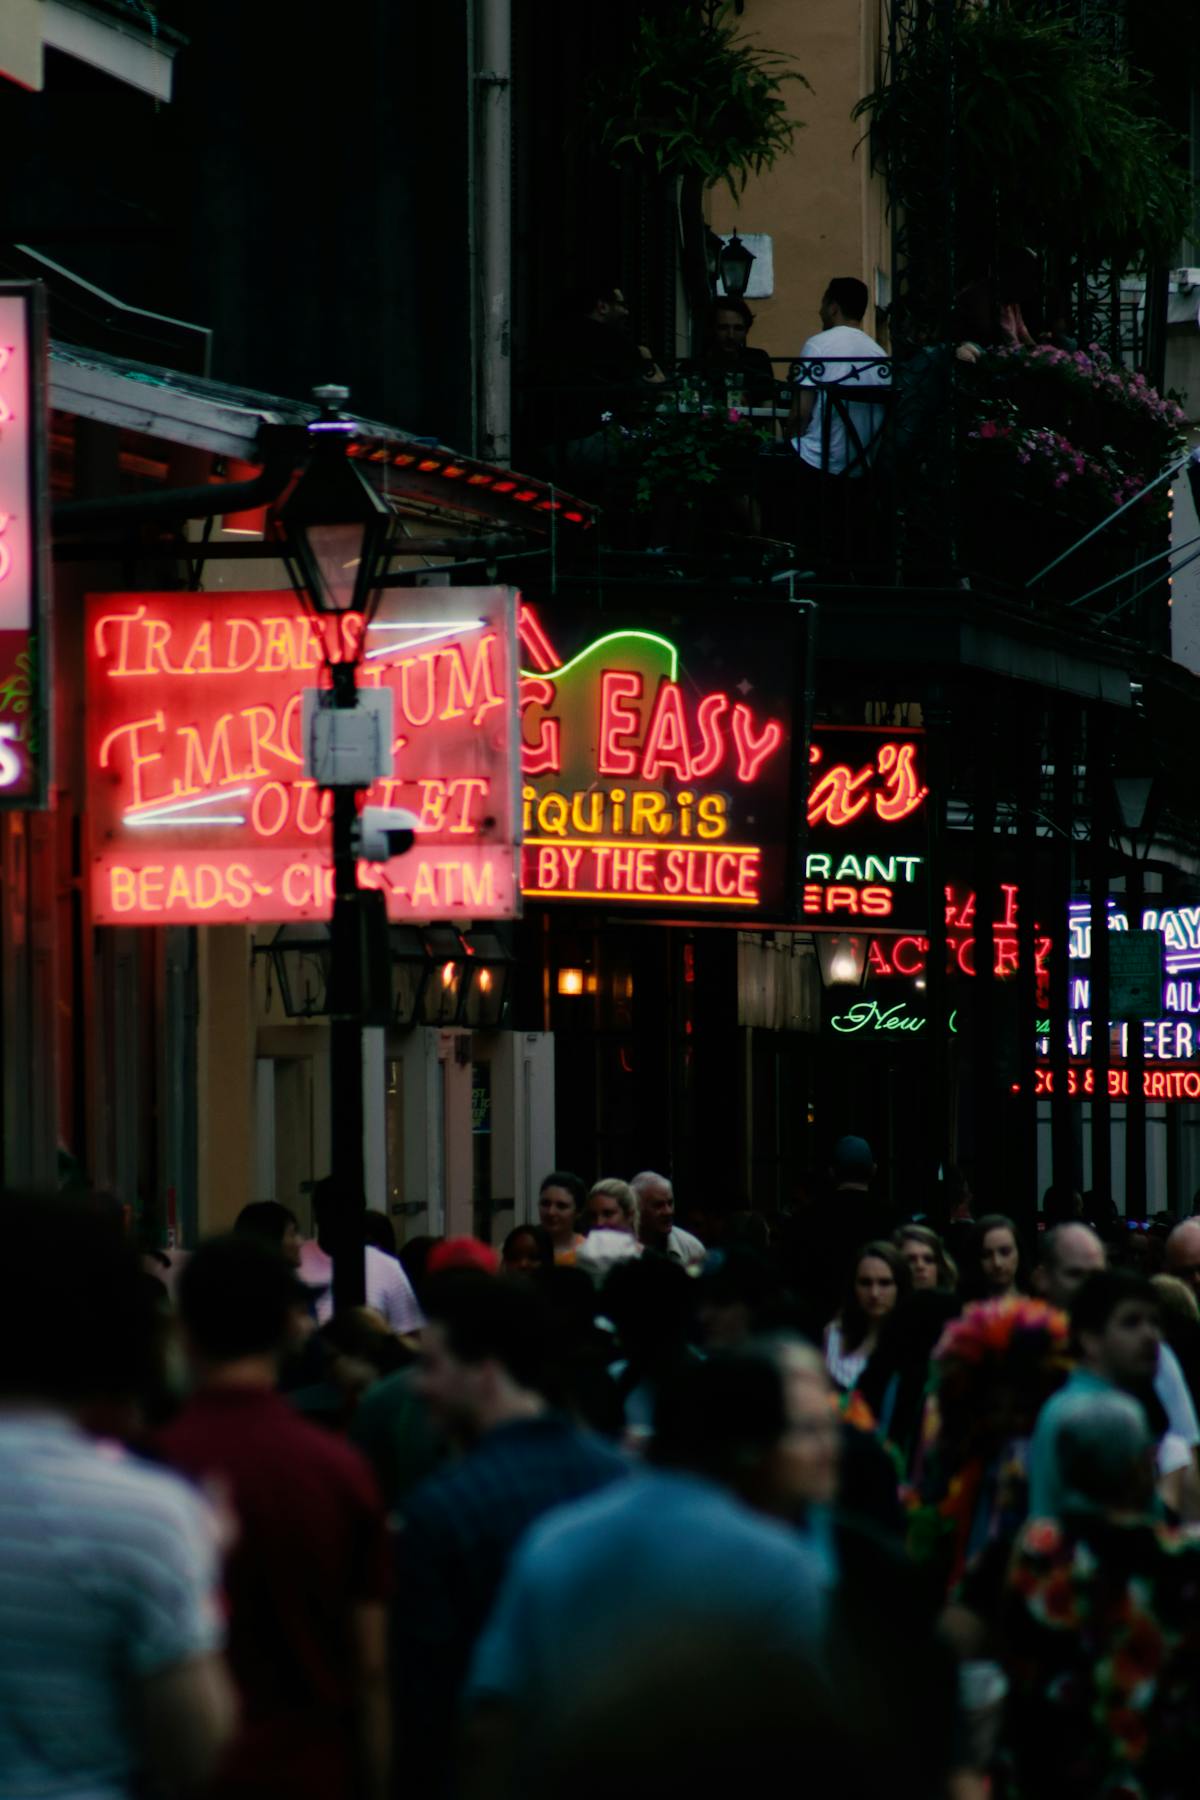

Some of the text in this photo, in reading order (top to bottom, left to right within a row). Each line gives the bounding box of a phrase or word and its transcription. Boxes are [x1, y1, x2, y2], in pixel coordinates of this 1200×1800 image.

[600, 671, 782, 782] EASY
[538, 847, 760, 899] BY THE SLICE
[831, 1000, 927, 1034] New
